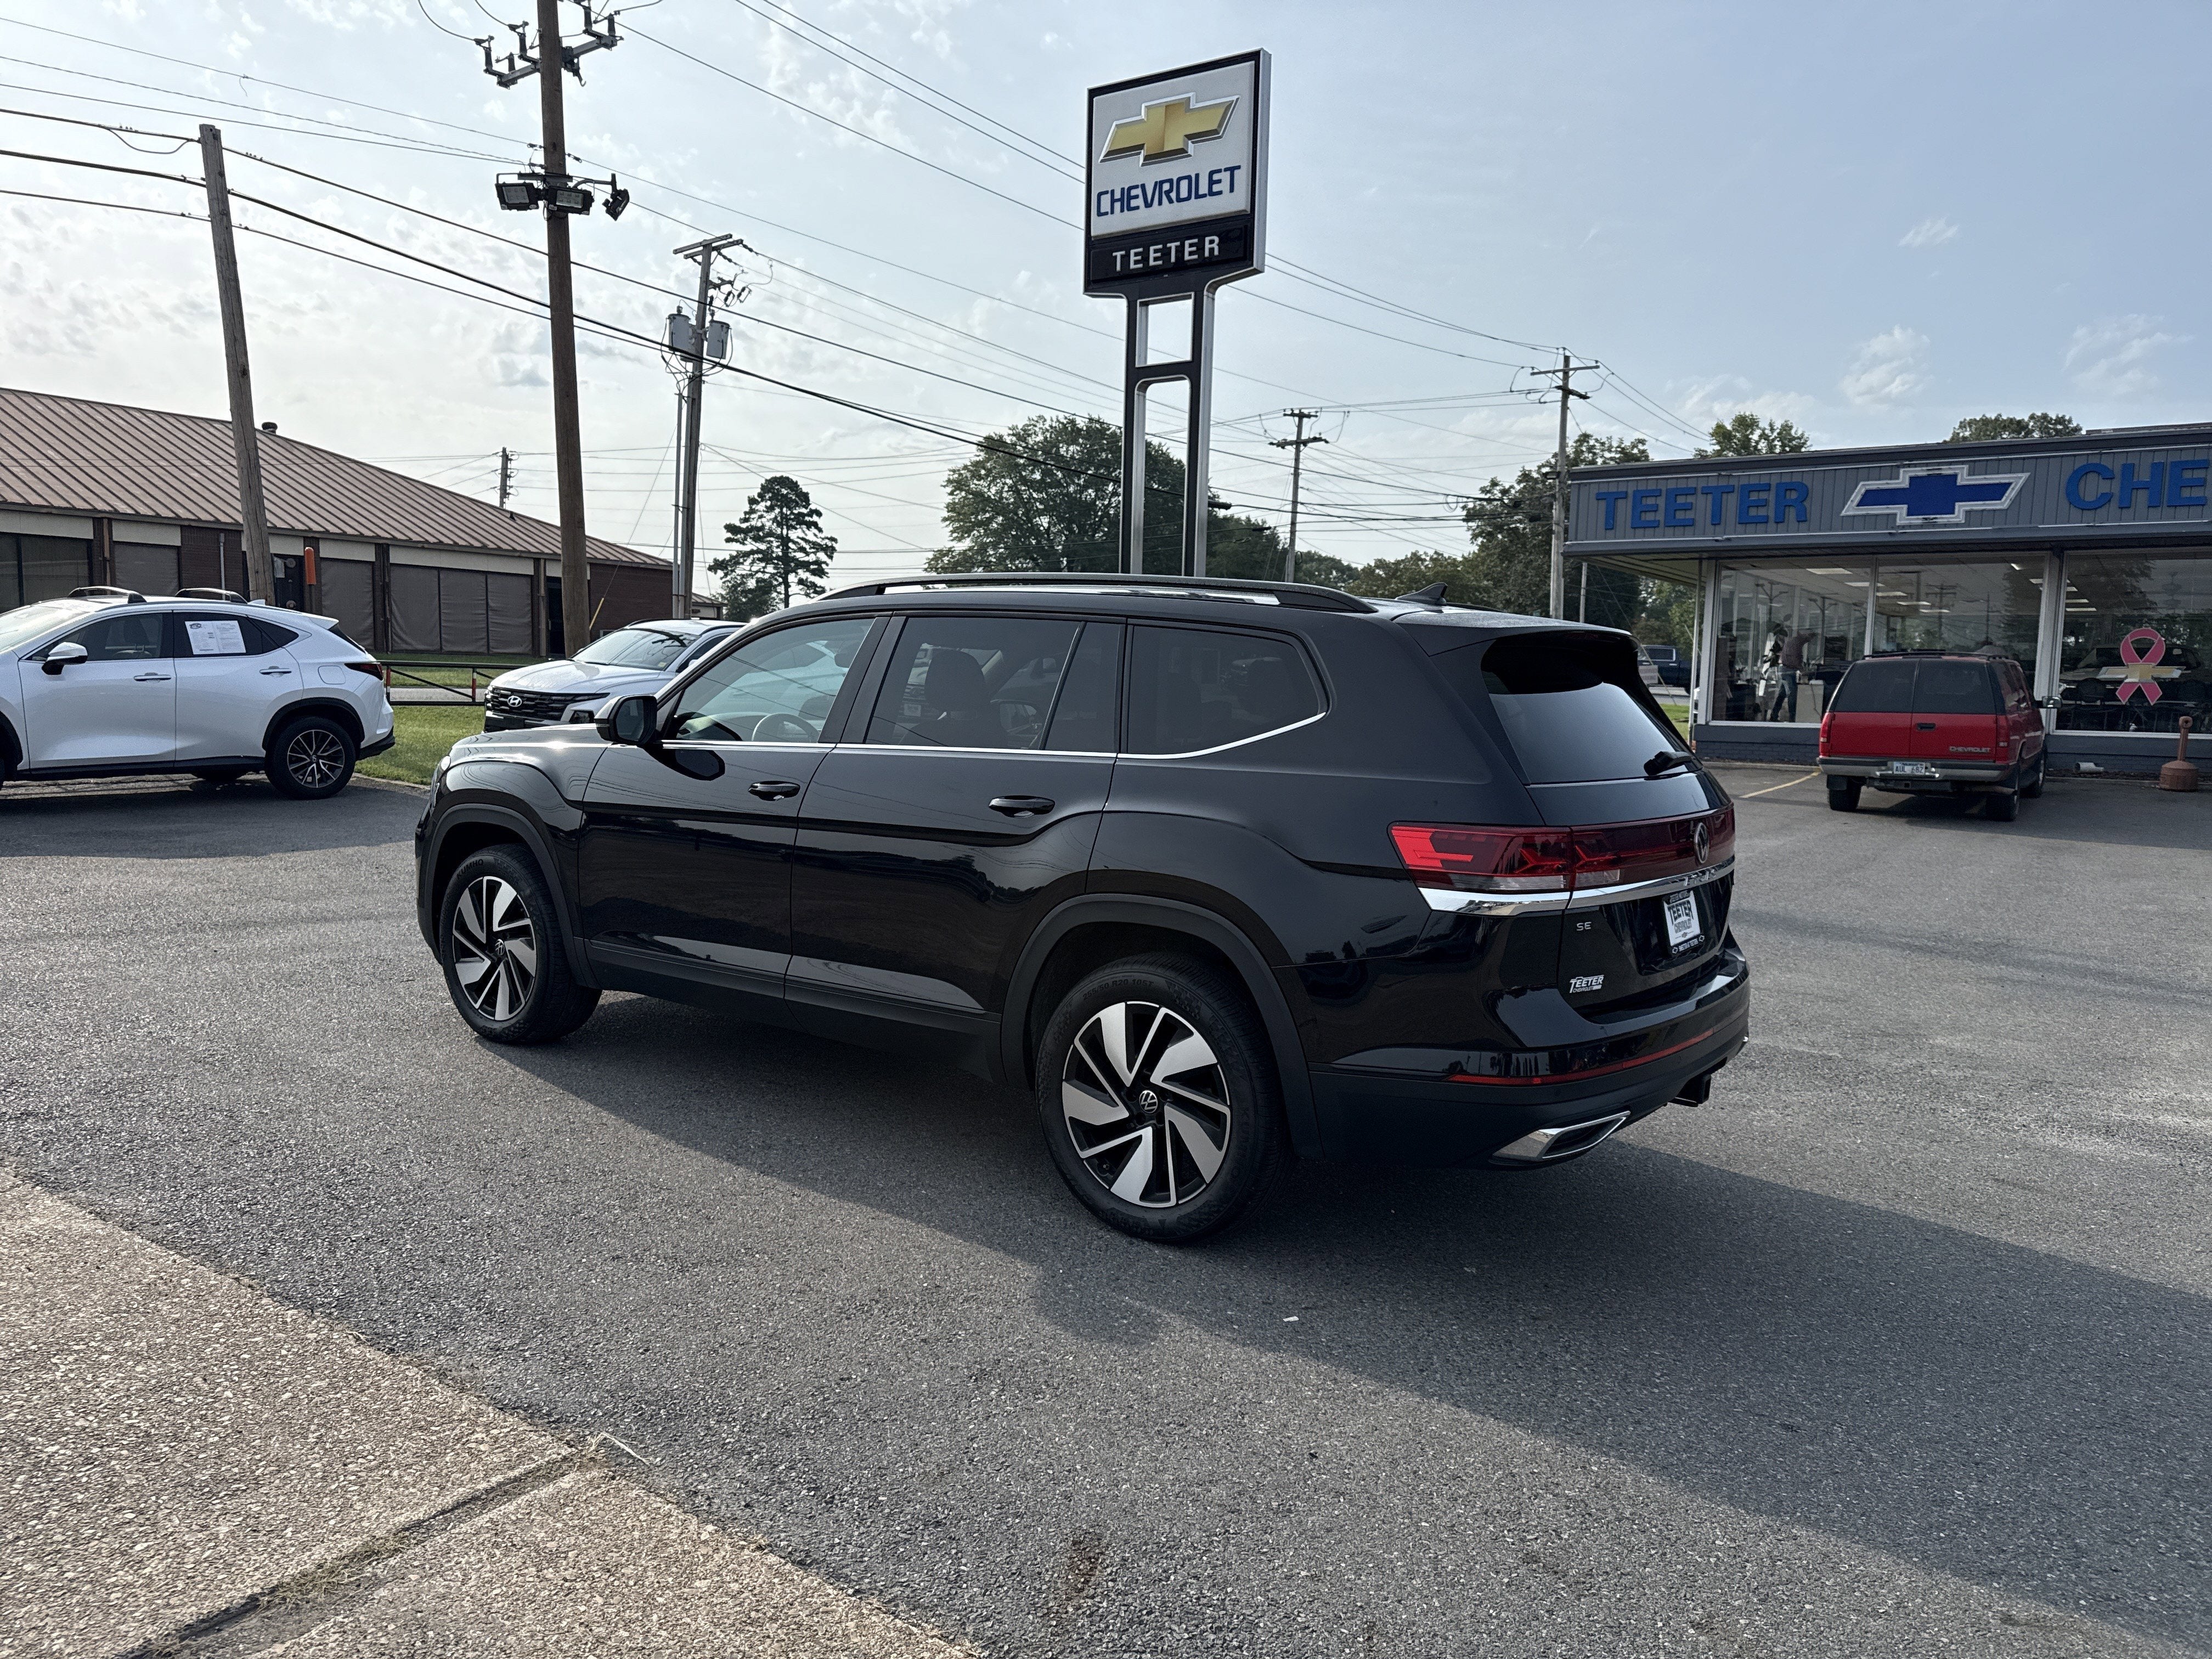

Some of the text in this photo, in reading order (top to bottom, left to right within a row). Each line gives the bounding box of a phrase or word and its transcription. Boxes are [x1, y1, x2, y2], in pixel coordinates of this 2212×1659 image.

[1097, 165, 1241, 217] CHEVROLET
[1112, 235, 1219, 272] TEETER
[1596, 459, 2210, 530] TEETER CHE
[456, 859, 484, 879] KUMHO
[1667, 899, 1694, 926] TEETER
[1576, 922, 1592, 931] SE
[1083, 979, 1154, 1000] 255/50 R20 105T
[1569, 976, 1604, 993] TEETER
